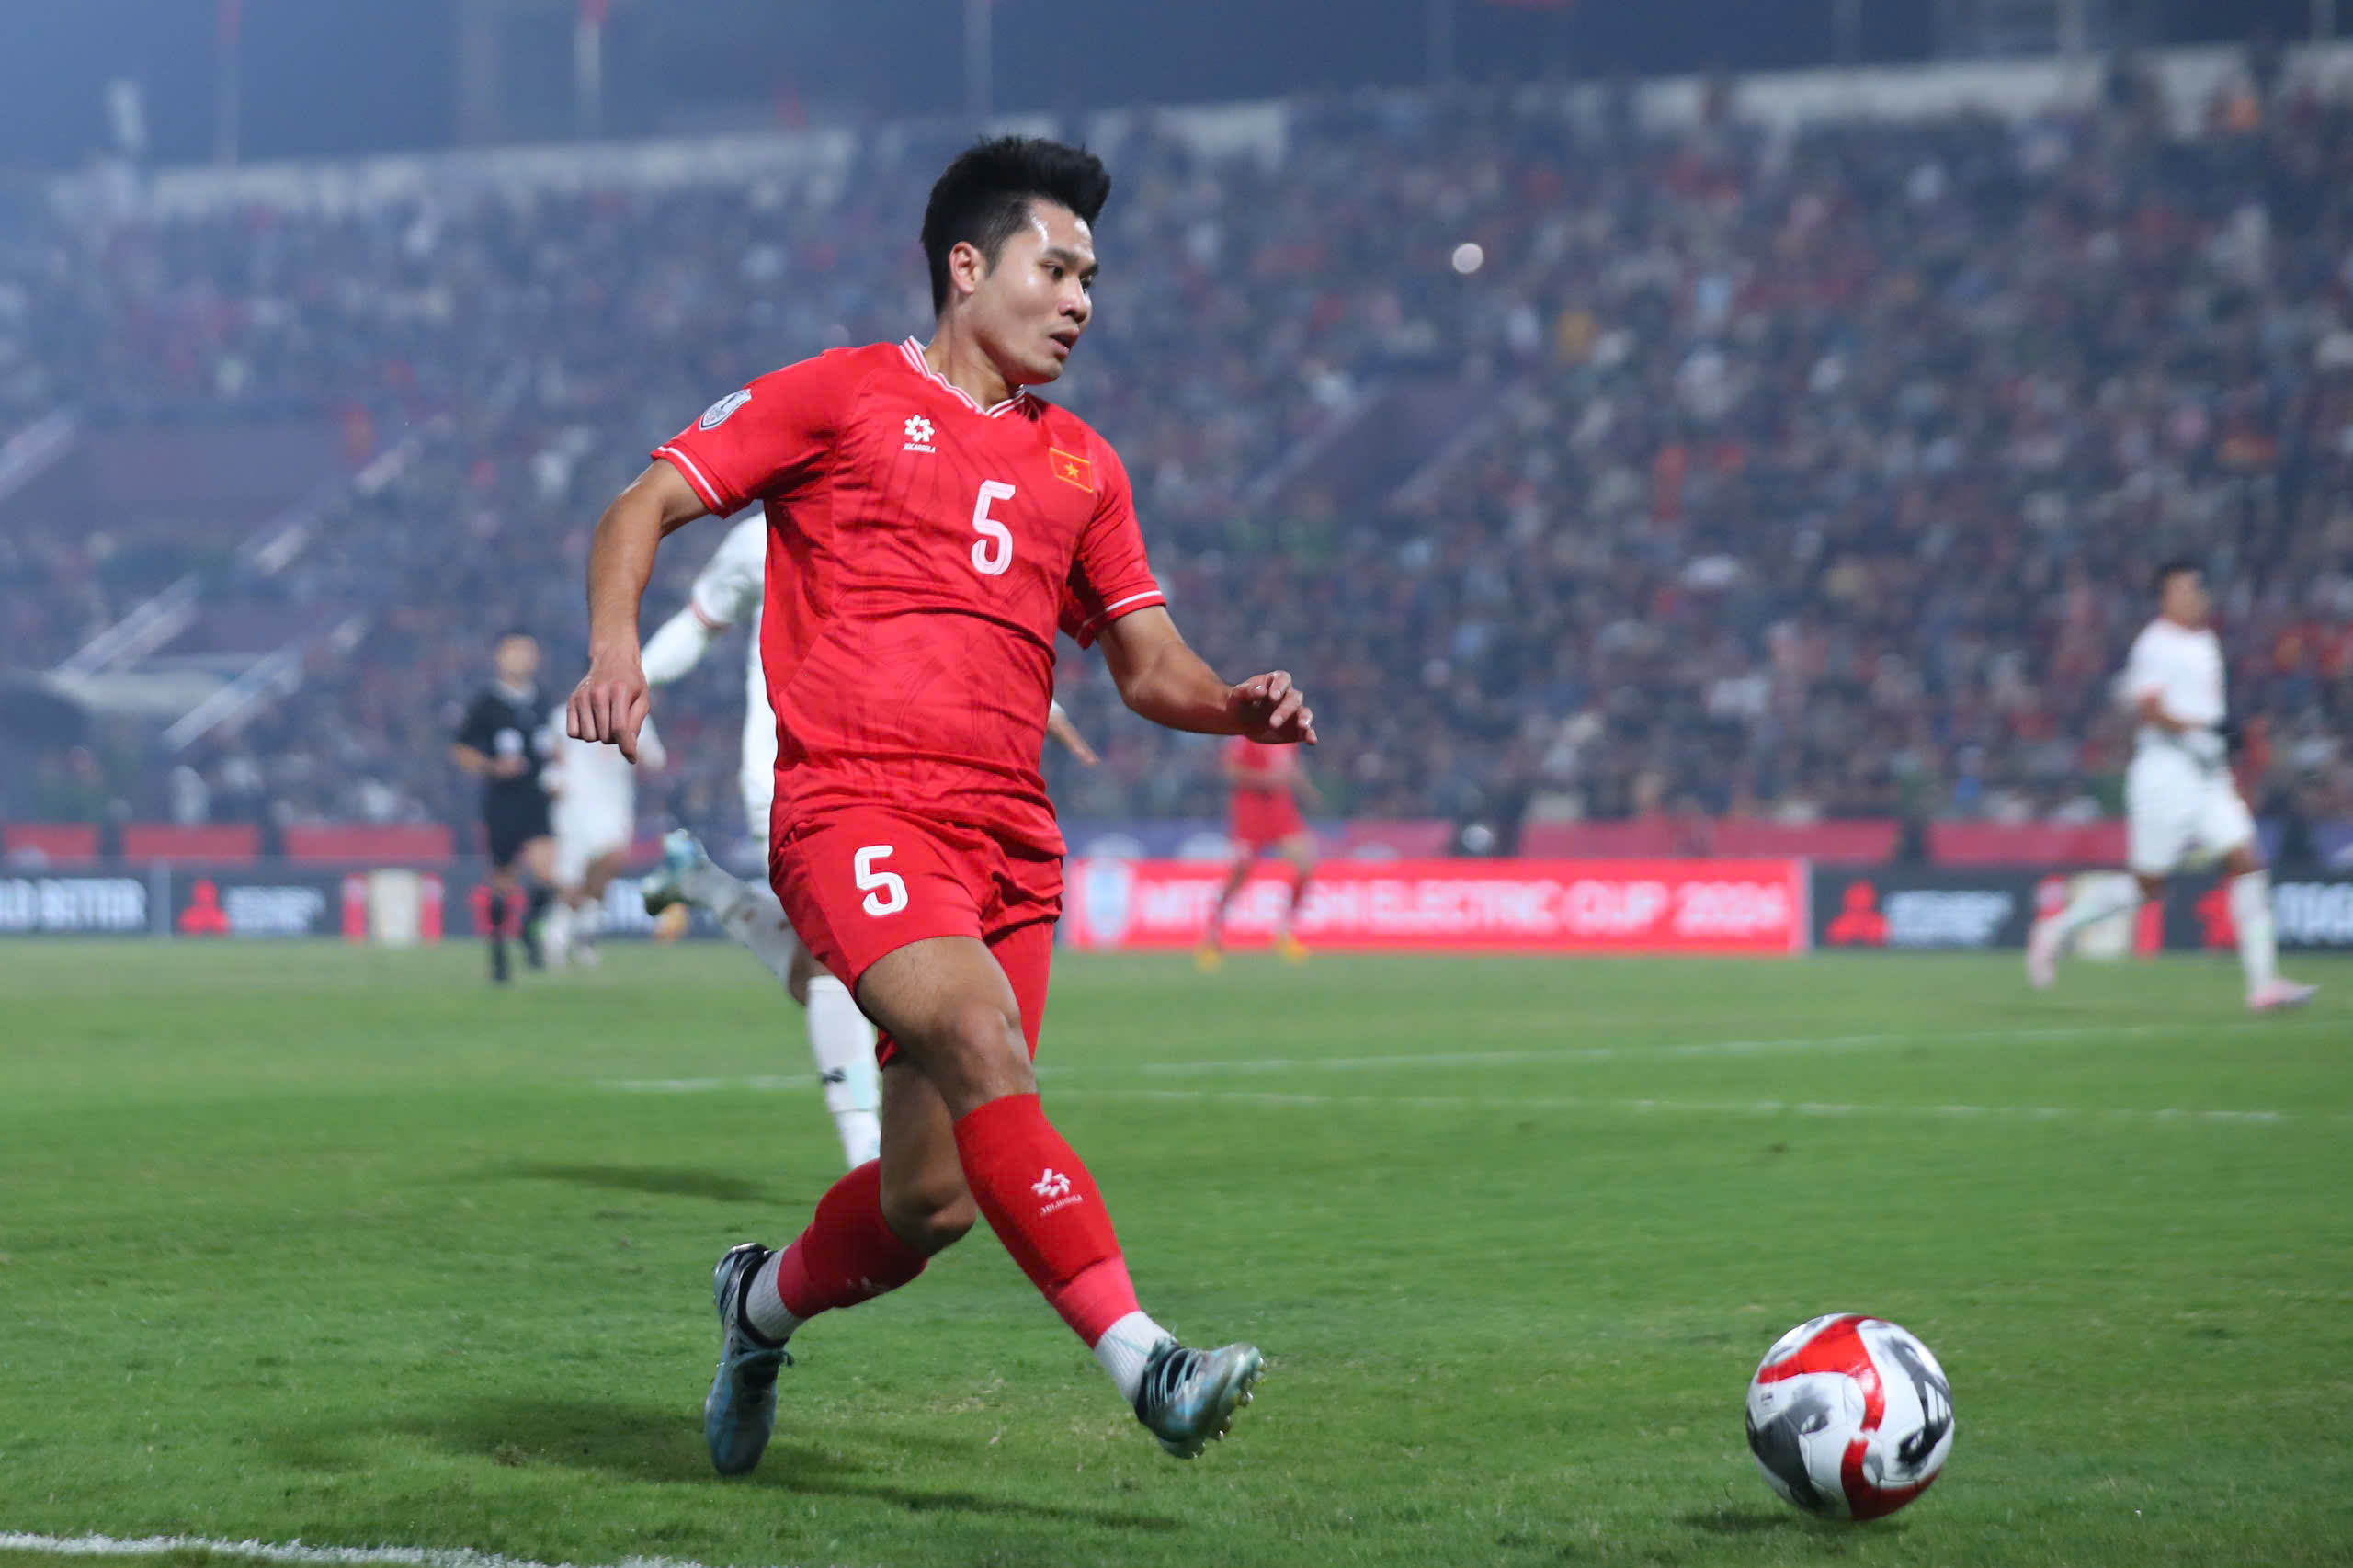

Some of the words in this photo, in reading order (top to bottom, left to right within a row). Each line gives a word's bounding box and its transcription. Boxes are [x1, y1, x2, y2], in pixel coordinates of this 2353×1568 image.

[971, 479, 1016, 576] 5
[854, 845, 909, 916] 5
[1566, 880, 1668, 932] CUP
